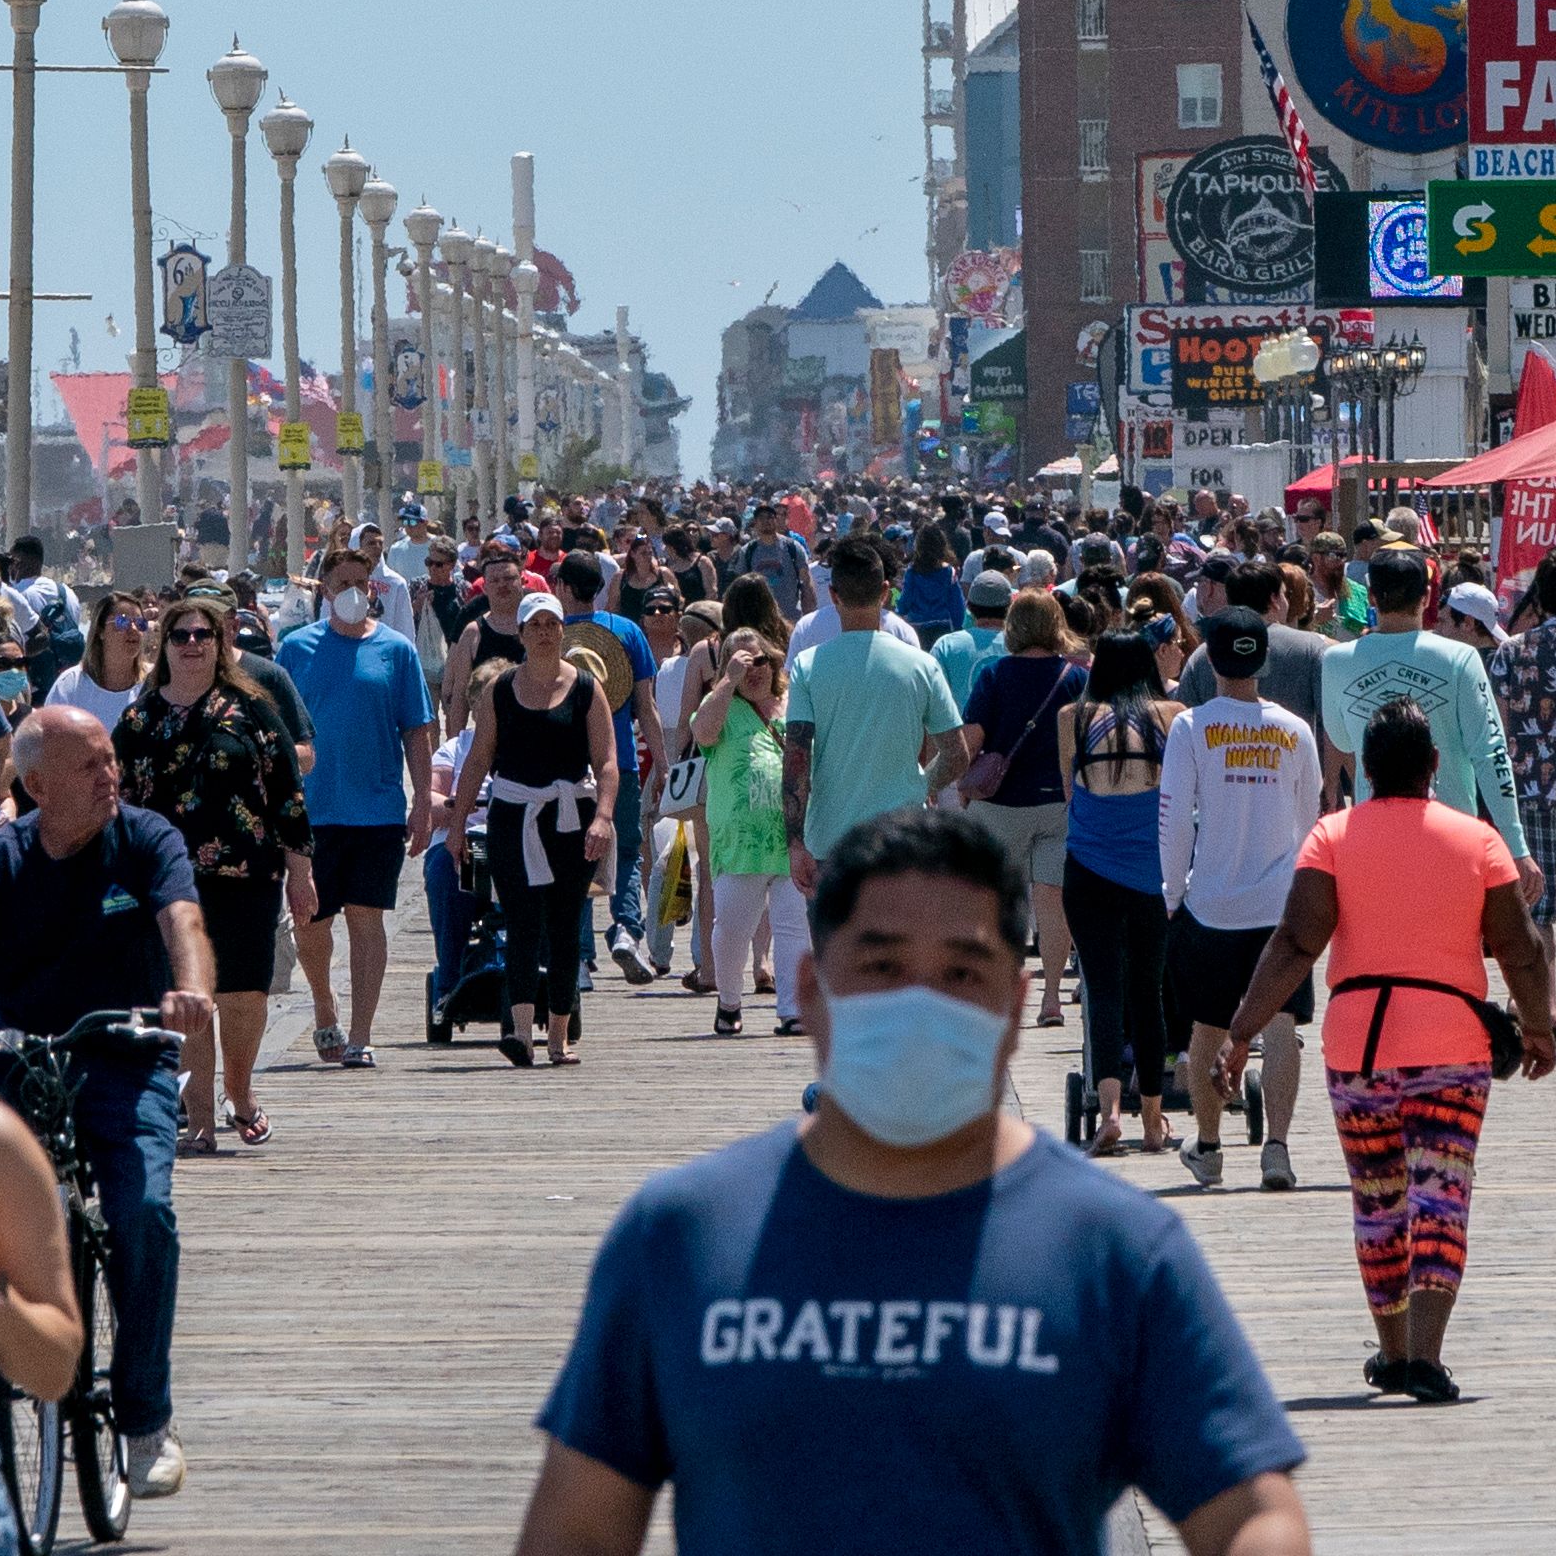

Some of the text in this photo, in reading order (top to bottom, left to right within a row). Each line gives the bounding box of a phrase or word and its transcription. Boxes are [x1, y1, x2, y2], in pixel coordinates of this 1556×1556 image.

[1334, 78, 1404, 134] KITE
[1184, 428, 1232, 445] OPEN
[1191, 467, 1226, 487] FOR
[1357, 667, 1430, 692] SALTY CREW
[700, 1298, 1059, 1374] GRATEFUL
